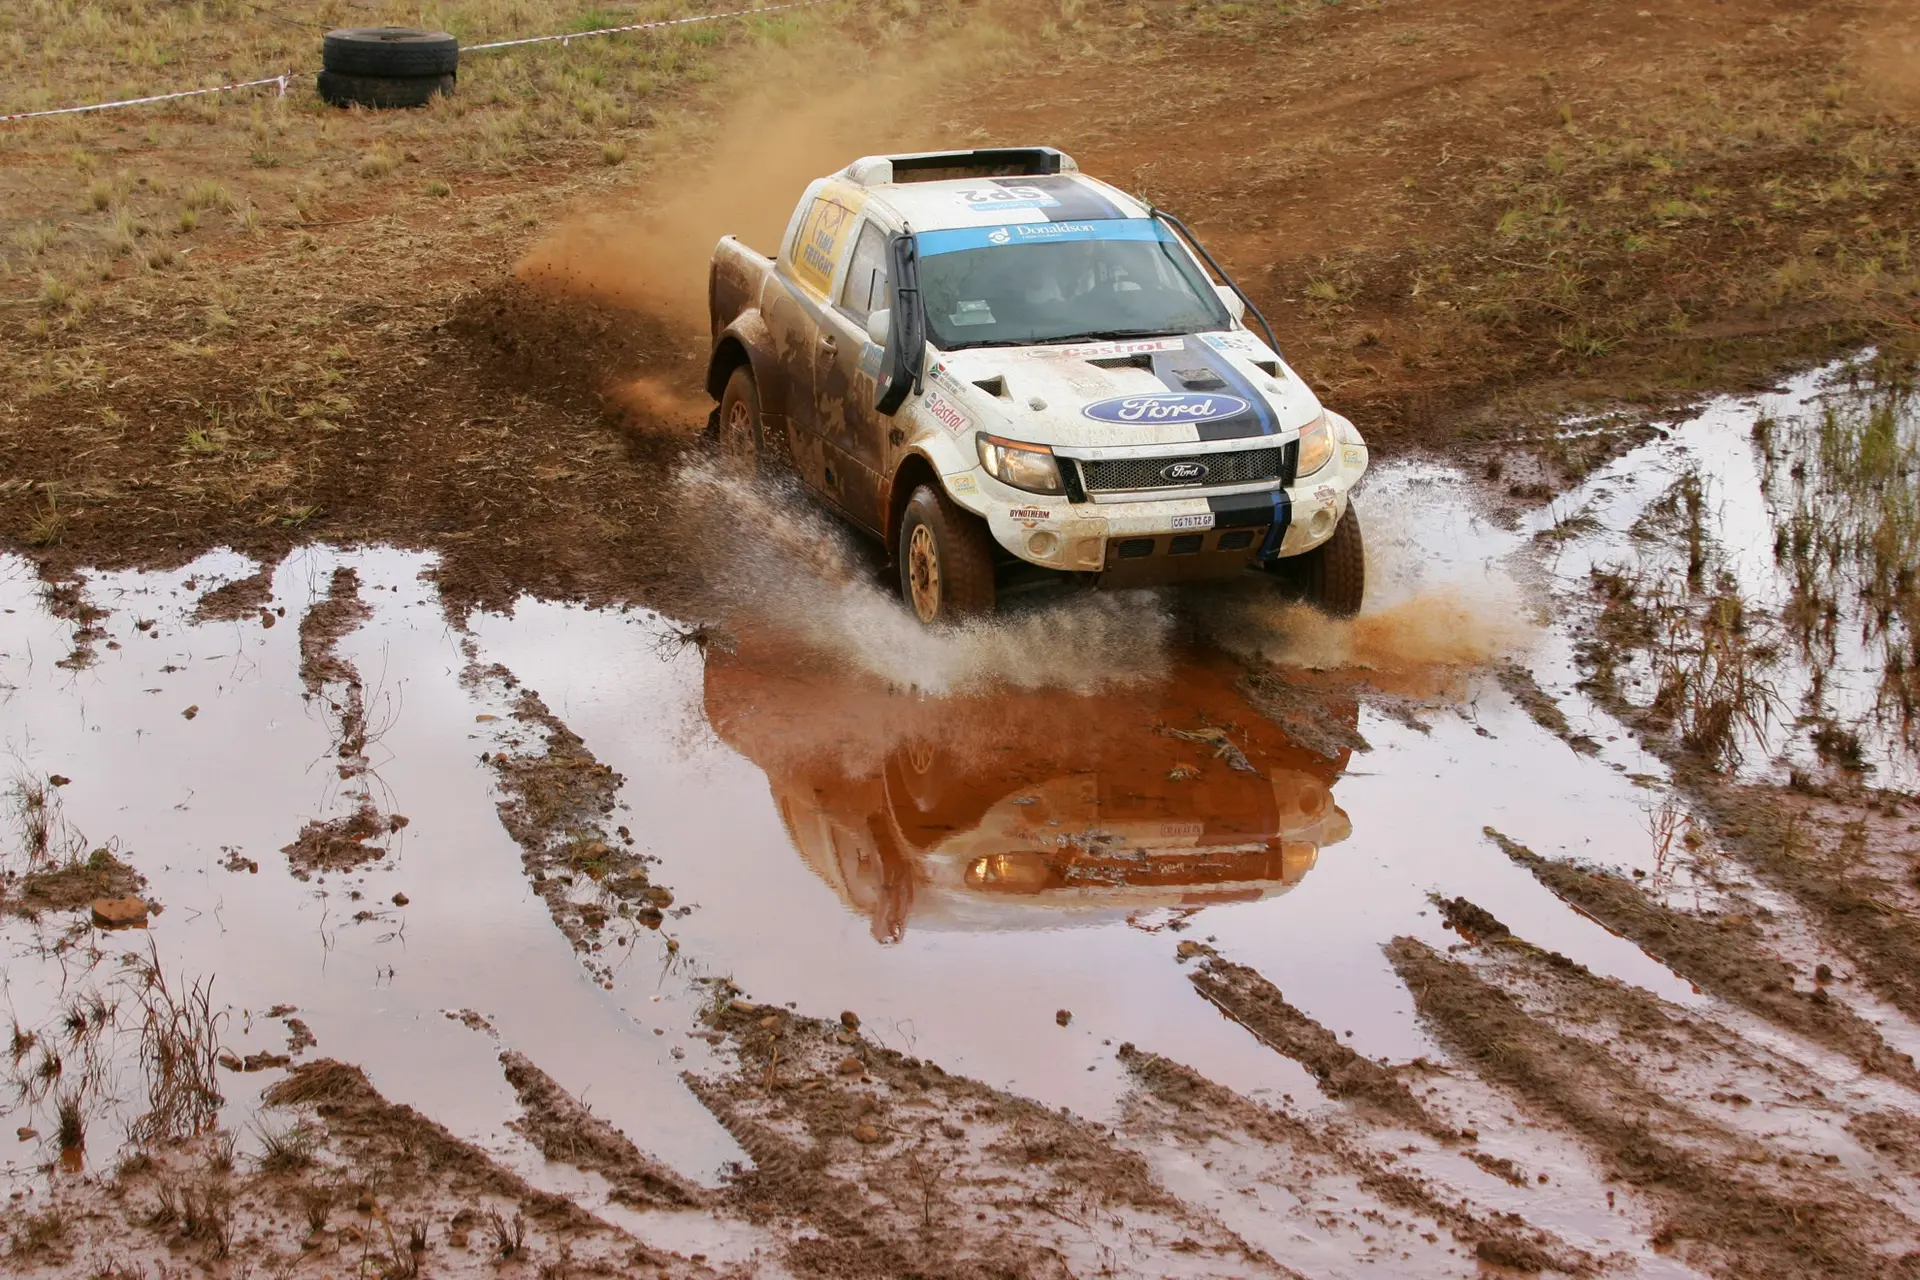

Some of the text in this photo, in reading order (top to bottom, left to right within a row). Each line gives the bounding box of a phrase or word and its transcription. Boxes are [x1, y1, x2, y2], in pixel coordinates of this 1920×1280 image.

[957, 187, 1041, 202] SP2
[1017, 222, 1096, 236] Donaldson
[816, 229, 835, 256] TIME
[803, 243, 835, 278] FREIGHT
[1062, 341, 1167, 357] Castrol
[931, 399, 966, 431] Castrol
[1118, 396, 1217, 420] Ford
[1172, 465, 1199, 477] Ford
[1009, 509, 1050, 519] DYNOTHERM
[1173, 518, 1183, 527] CG
[1185, 517, 1193, 526] 76
[1203, 515, 1212, 525] GP
